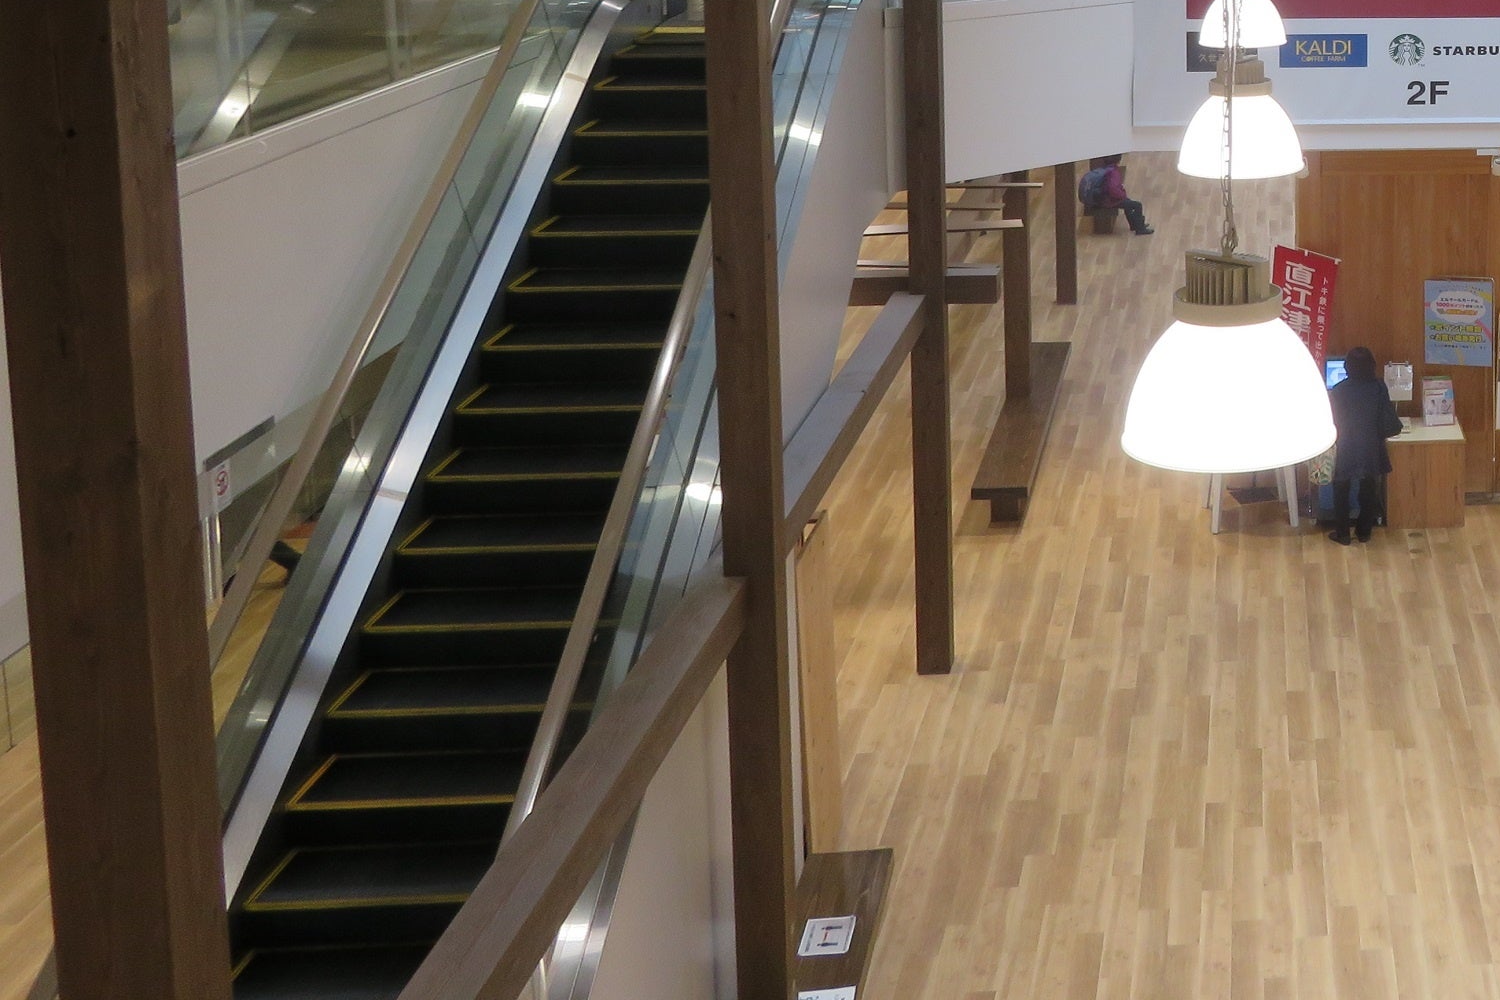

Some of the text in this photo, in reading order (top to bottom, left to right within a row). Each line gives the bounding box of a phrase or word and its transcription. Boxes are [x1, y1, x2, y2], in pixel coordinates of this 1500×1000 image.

[1295, 39, 1352, 55] KALDI
[1407, 80, 1449, 105] 2F
[1281, 260, 1316, 348] 直江津
